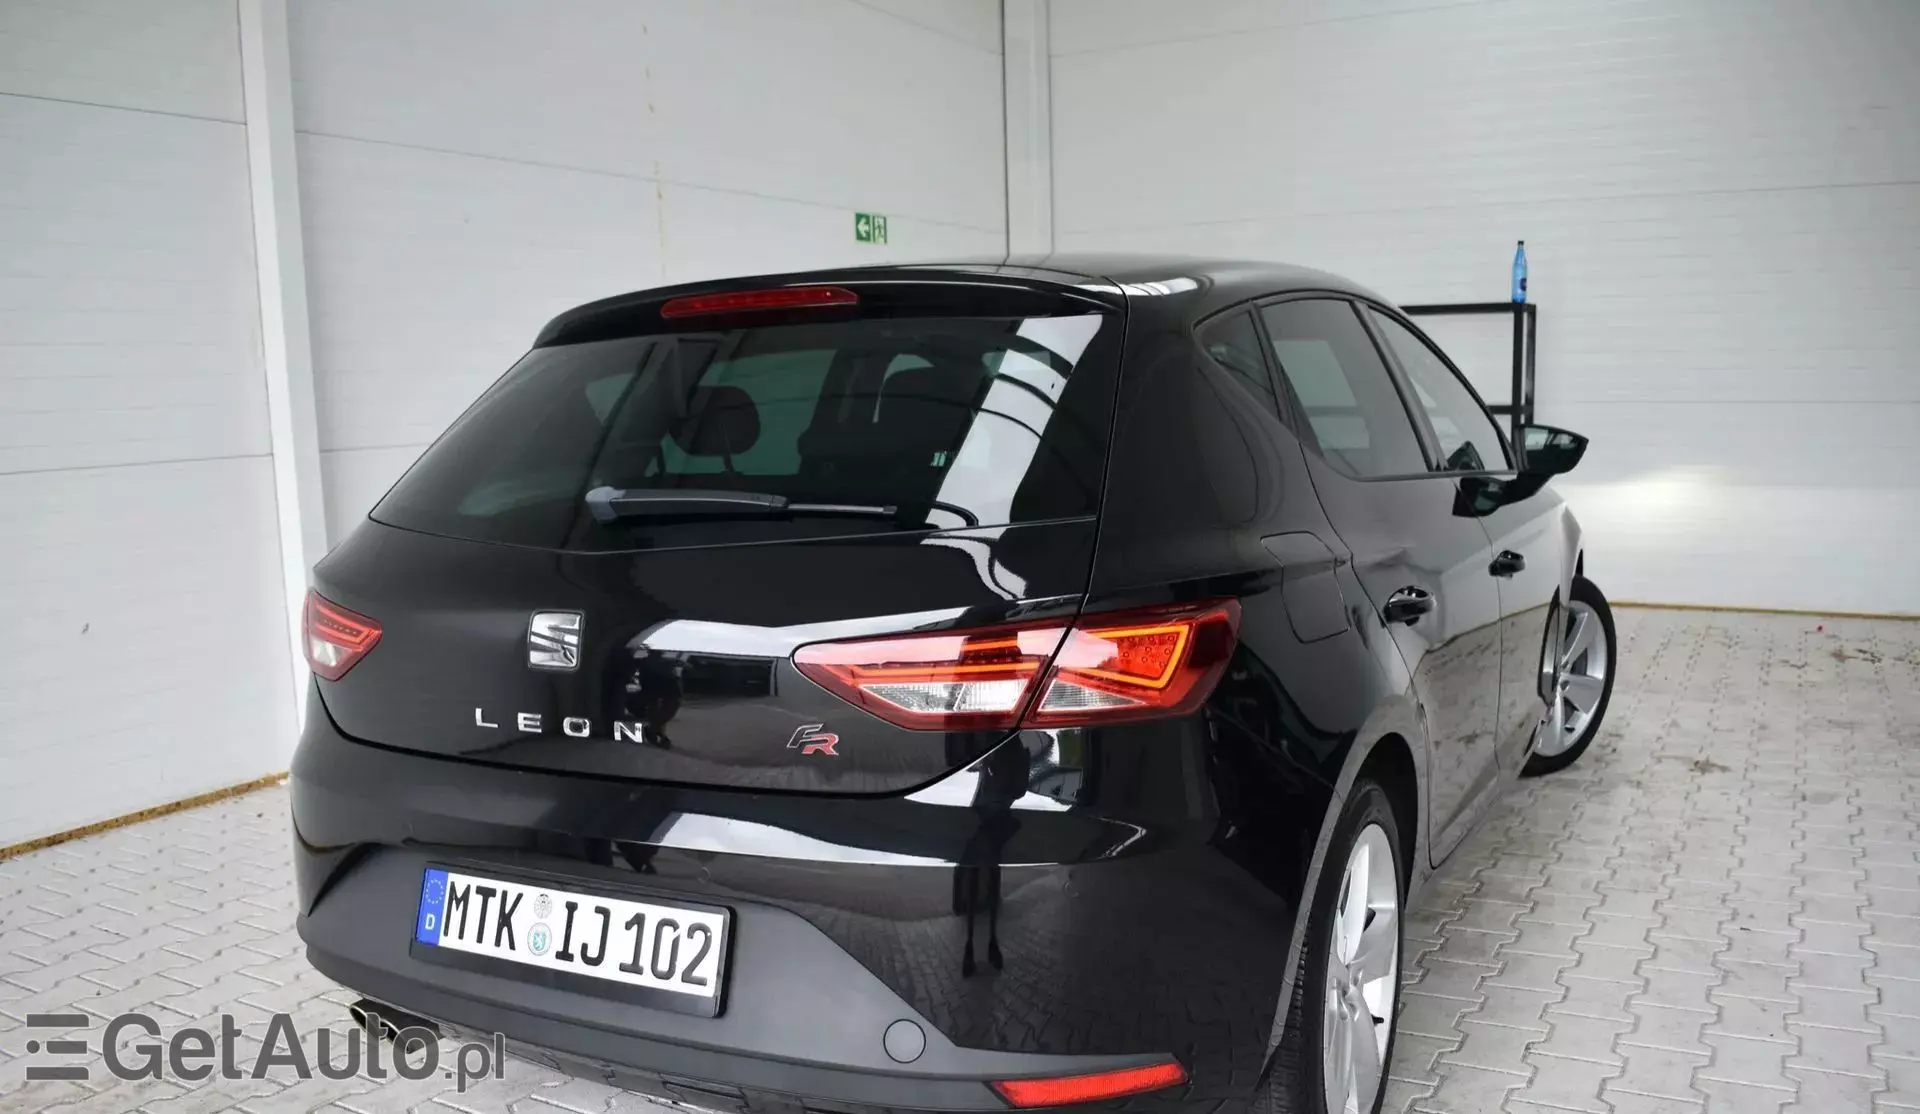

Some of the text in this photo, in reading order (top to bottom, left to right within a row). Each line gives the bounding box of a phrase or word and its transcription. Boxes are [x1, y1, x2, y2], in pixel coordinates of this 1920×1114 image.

[475, 707, 643, 744] LEON
[786, 722, 840, 756] FR
[424, 913, 436, 931] D
[443, 881, 713, 987] MTK IJ 102
